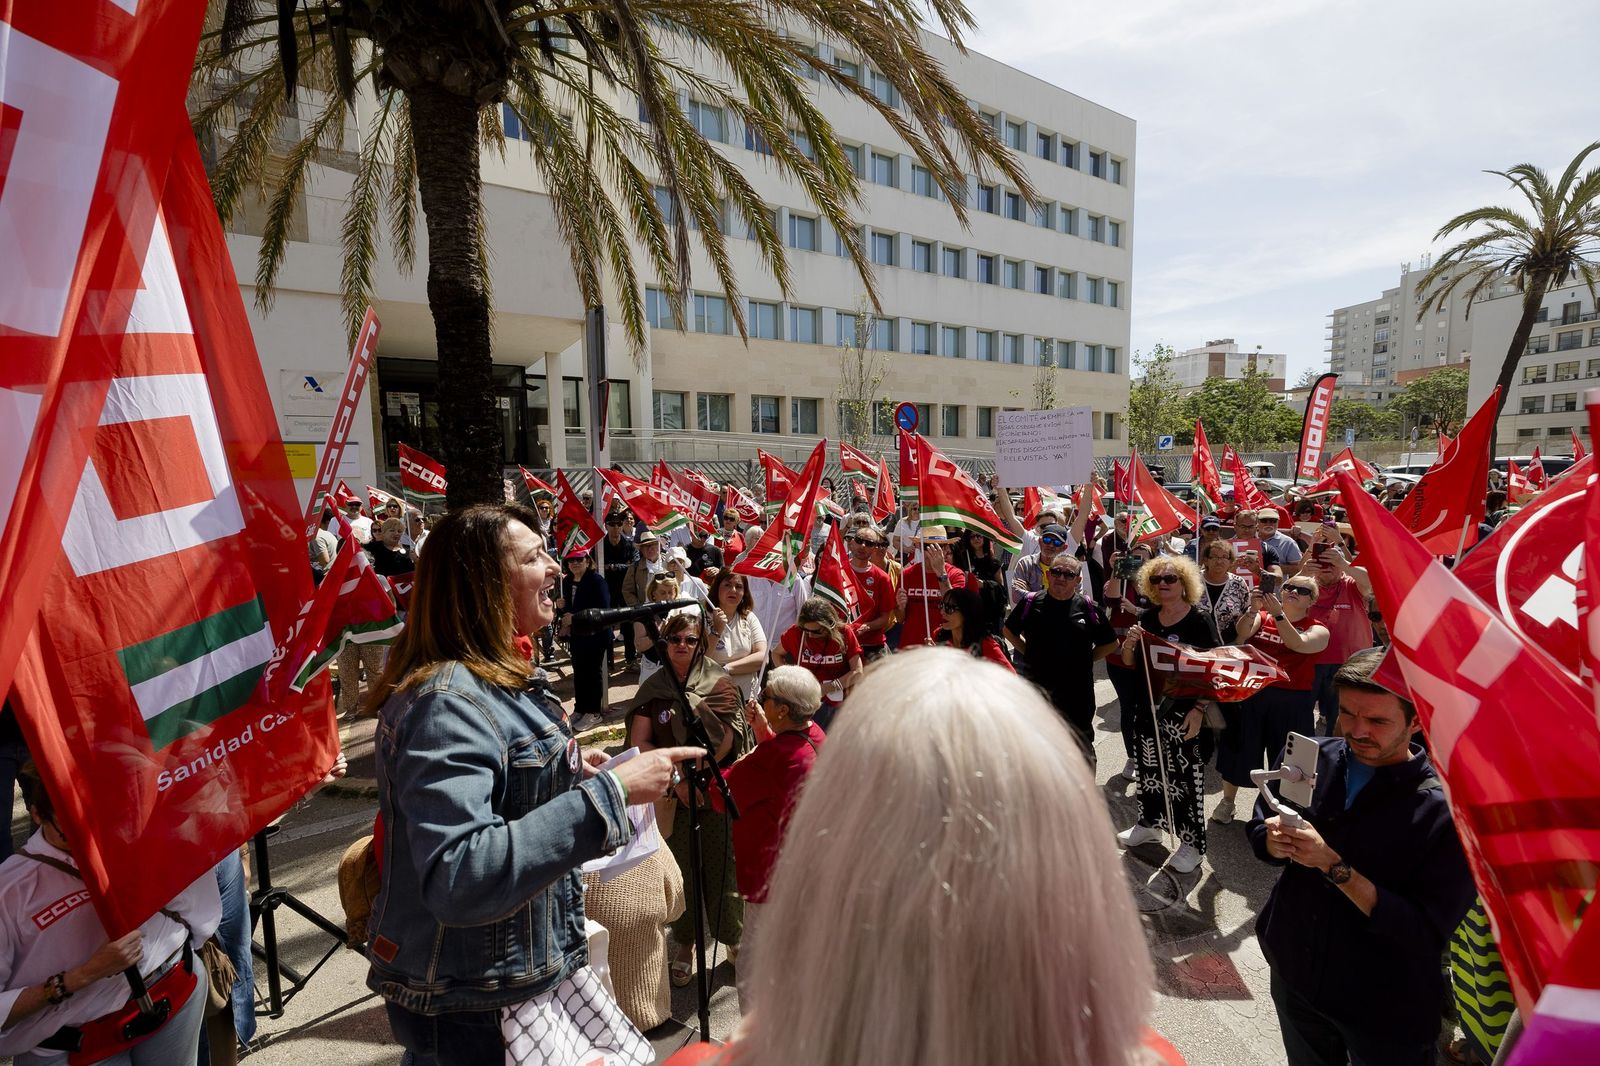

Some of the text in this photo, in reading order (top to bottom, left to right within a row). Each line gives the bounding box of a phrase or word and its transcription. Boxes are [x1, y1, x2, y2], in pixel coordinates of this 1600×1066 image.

[321, 320, 377, 485] CCOO
[998, 415, 1007, 424] EL
[1009, 413, 1038, 423] COMITÉ
[1304, 387, 1329, 467] CCOO
[400, 457, 446, 490] CCOO
[661, 476, 699, 513] CCOO
[908, 588, 939, 597] CCOO
[1150, 645, 1277, 681] CCOO
[157, 725, 253, 792] Sanidad
